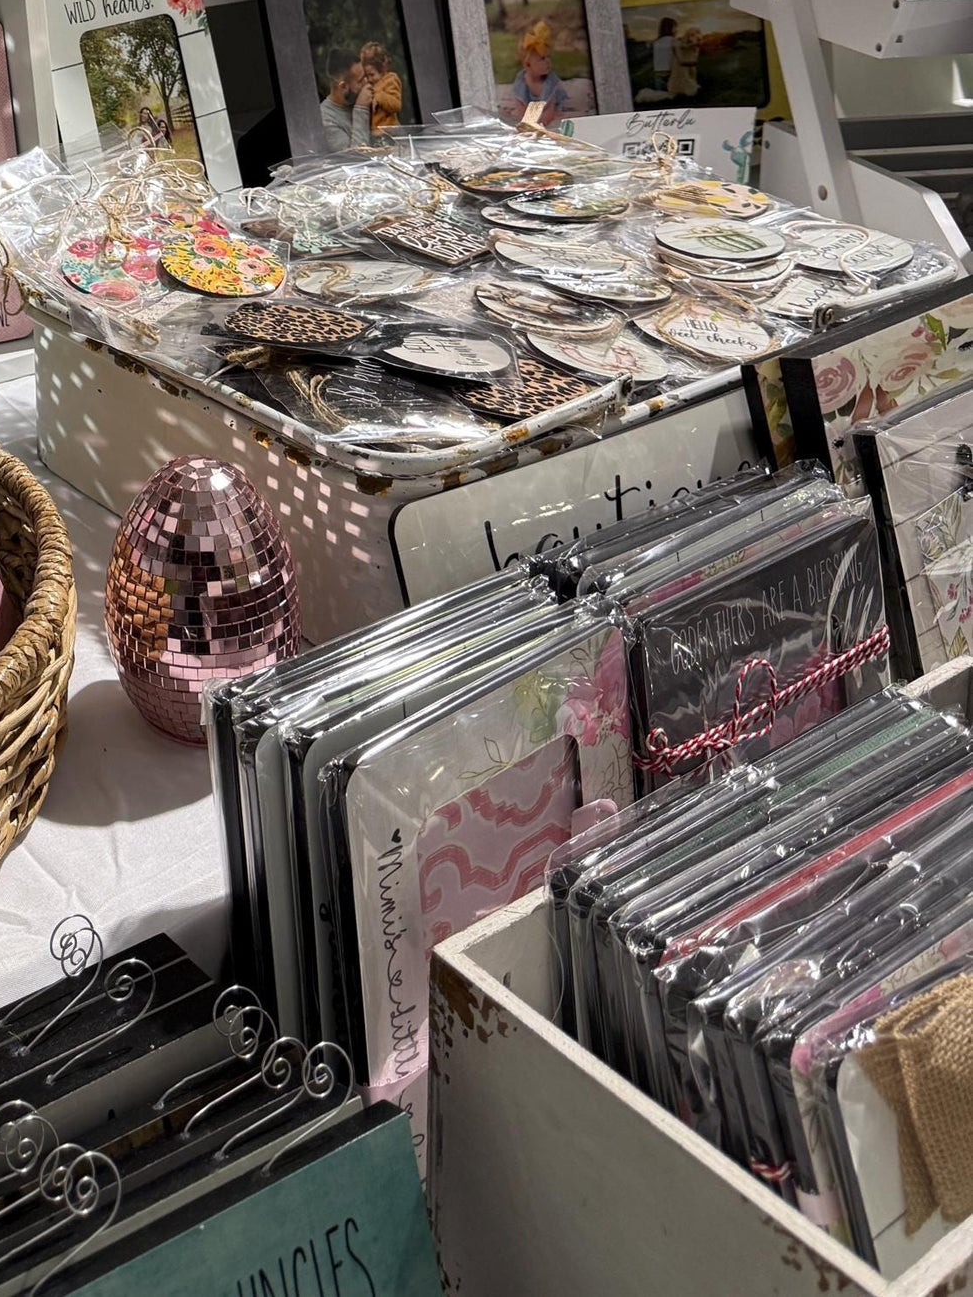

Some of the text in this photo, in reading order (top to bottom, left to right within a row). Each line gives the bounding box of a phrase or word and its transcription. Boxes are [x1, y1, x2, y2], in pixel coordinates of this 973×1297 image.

[64, 0, 96, 25] WILD
[684, 317, 718, 332] HELLO
[670, 550, 863, 675] GODFATHERS ARE A BLESSING
[377, 843, 407, 951] Mimi's
[237, 1217, 376, 1297] CLES
